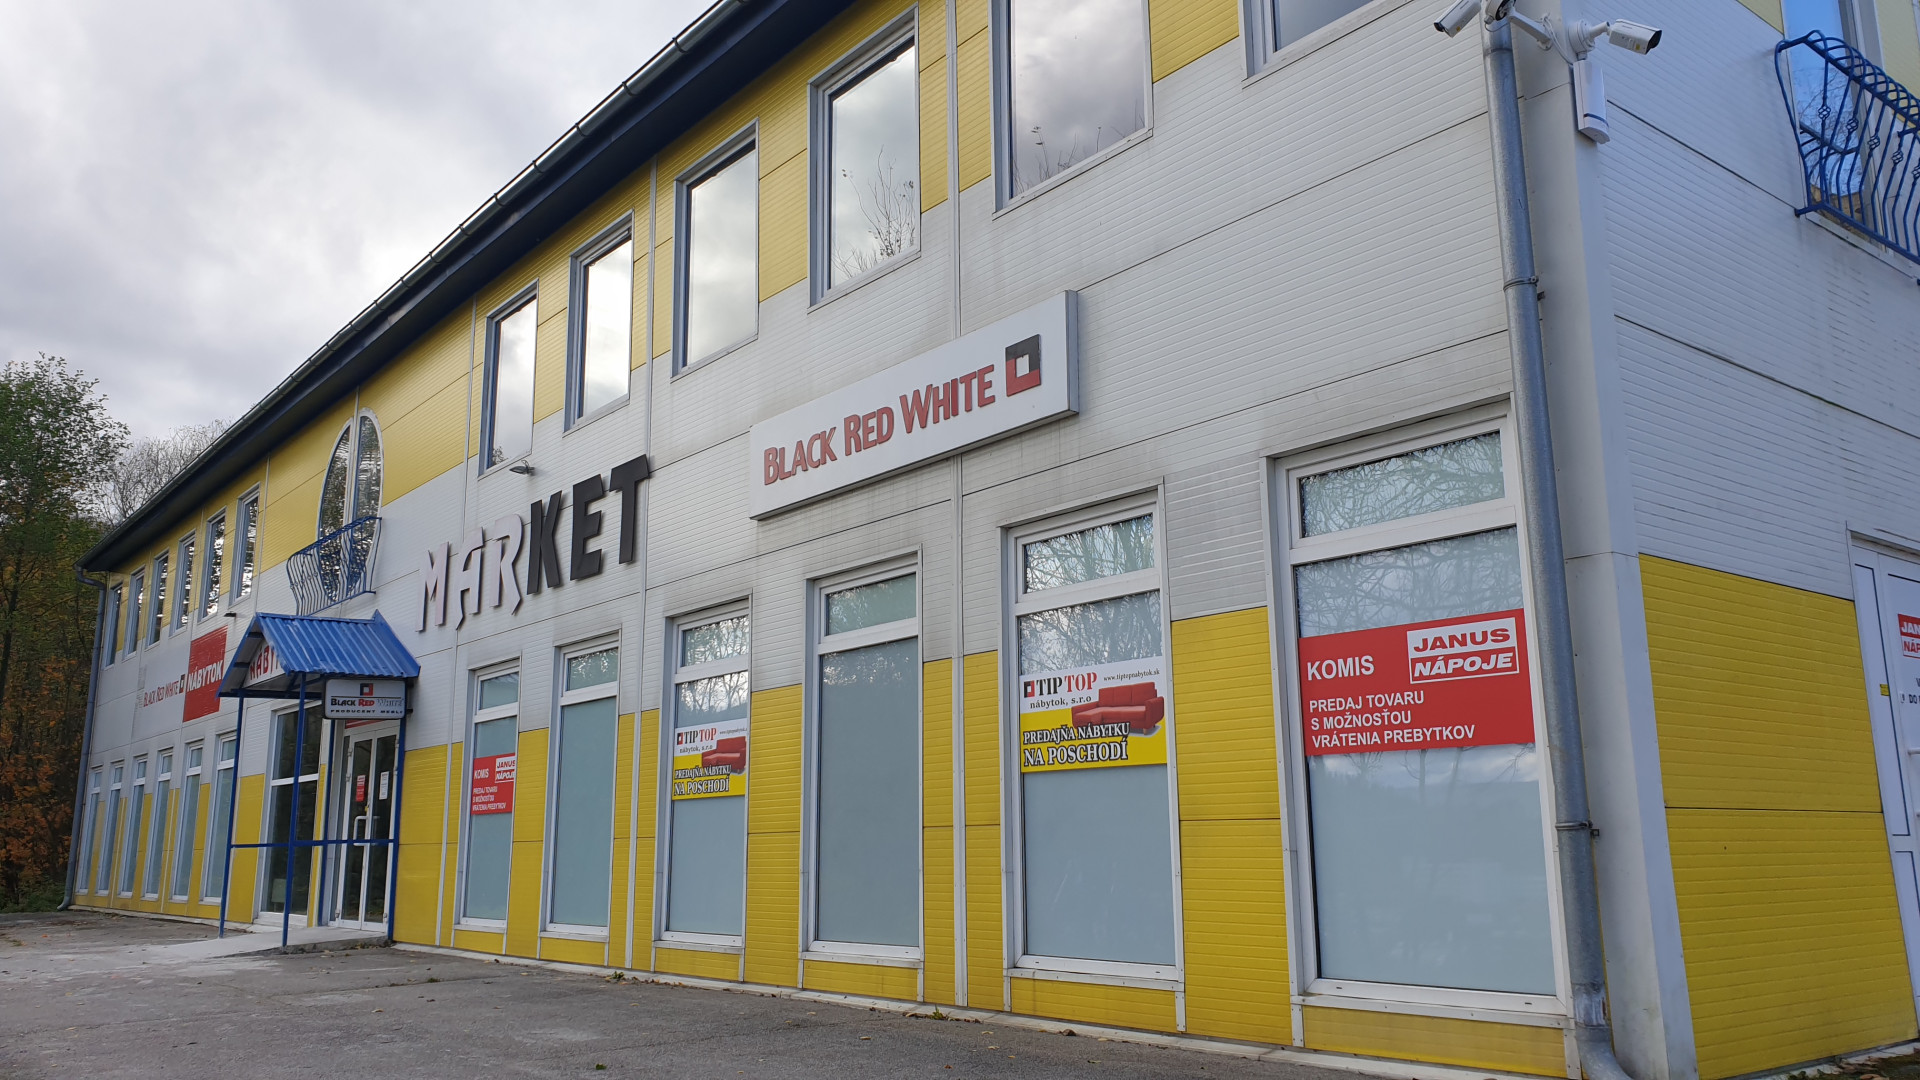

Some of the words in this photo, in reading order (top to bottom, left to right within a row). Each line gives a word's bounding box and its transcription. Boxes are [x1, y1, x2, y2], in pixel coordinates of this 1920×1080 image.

[764, 427, 837, 486] BLACK
[844, 406, 894, 456] RED
[900, 364, 996, 434] WHITE
[415, 454, 650, 633] MARKET
[1413, 628, 1511, 653] JANUS
[187, 660, 224, 692] NÁBYTOK
[1103, 668, 1160, 682] www.tiptopnabytok.sk
[1307, 655, 1375, 681] KOMIS
[1413, 653, 1513, 677] NÁPOJE
[331, 698, 356, 707] BLACK
[358, 698, 375, 707] RED
[1030, 696, 1069, 709] nábytok,
[1071, 695, 1092, 704] s.r.o
[1309, 696, 1363, 713] PREDAJ
[1366, 690, 1424, 708] TOVARU
[1311, 718, 1319, 731] S
[1323, 709, 1412, 730] MOŽNOSŤOU
[1023, 724, 1077, 745] PREDAJŇA
[1078, 722, 1131, 740] NÁBYTKU
[1312, 731, 1381, 749] VRÁTENIA
[1384, 724, 1476, 744] PREBYTKOV
[1023, 748, 1045, 767] NA
[1047, 735, 1129, 765] POSCHODÍ
[474, 768, 490, 780] KOMIS
[674, 765, 703, 779] PREDAJŇA
[703, 764, 732, 777] NÁBYTKU
[674, 782, 686, 796] NA
[687, 776, 730, 794] POSCHODÍ
